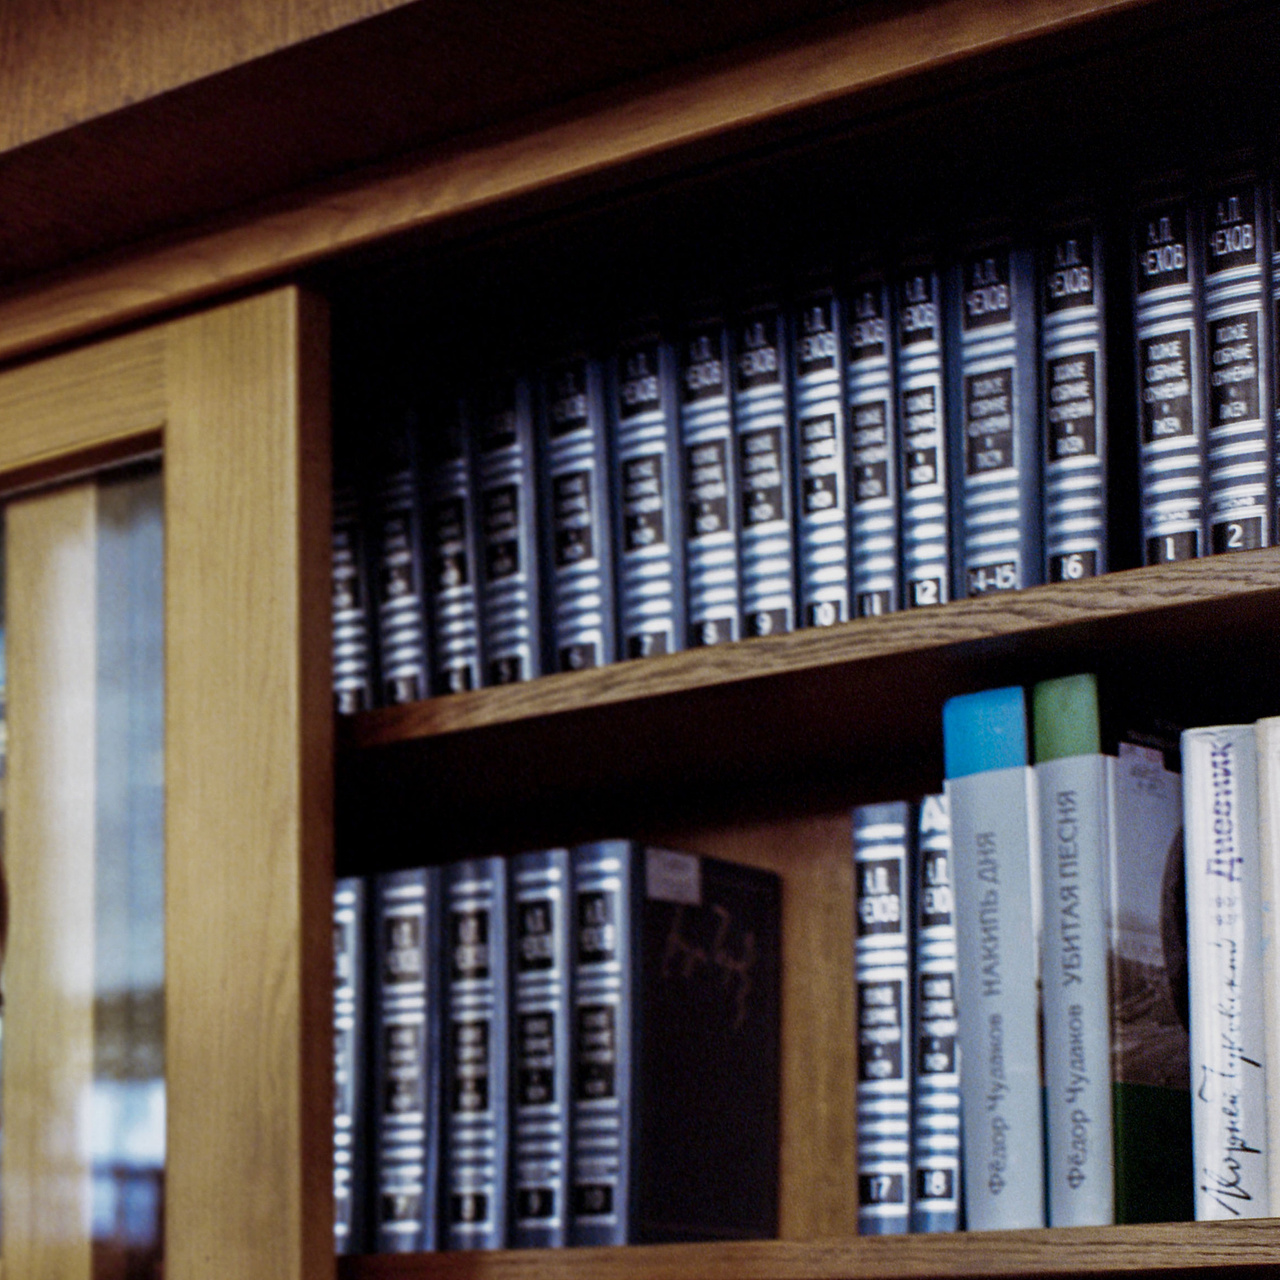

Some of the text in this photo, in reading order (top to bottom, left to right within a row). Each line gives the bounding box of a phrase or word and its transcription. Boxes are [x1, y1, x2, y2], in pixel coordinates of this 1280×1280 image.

[1166, 537, 1175, 560] 1
[1228, 524, 1243, 548] 2
[1062, 555, 1083, 580] 16
[916, 580, 937, 604] 12
[814, 602, 836, 627] 10
[1207, 742, 1244, 882] Дневник
[1057, 790, 1082, 987] УБИТАЯ ПЕСНЯ
[976, 831, 1001, 997] НАКИПЬ ДНЯ
[987, 1013, 1010, 1111] Чудаков
[1066, 1004, 1090, 1103] Чудаков
[871, 1176, 891, 1200] 17
